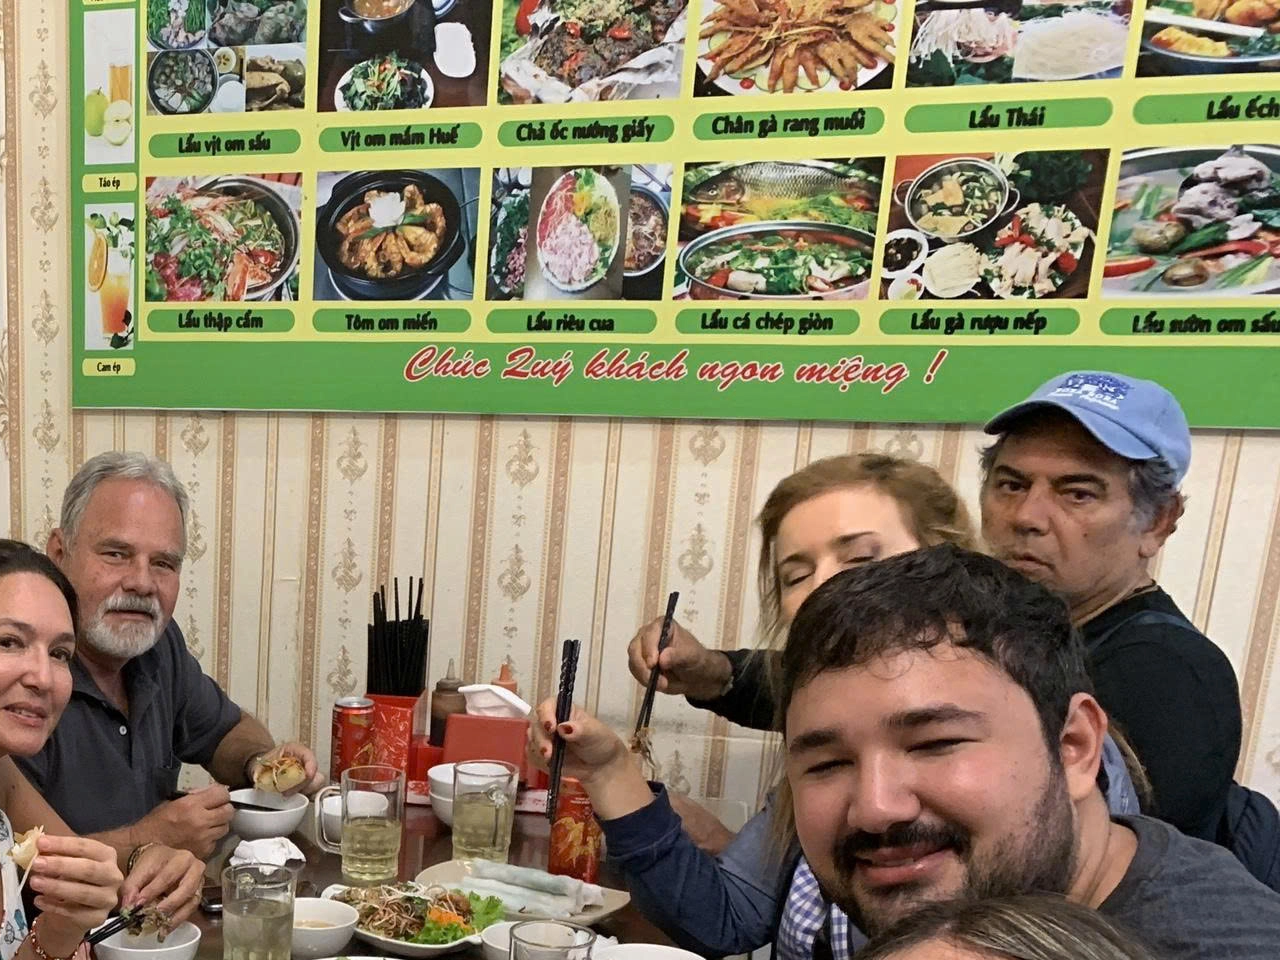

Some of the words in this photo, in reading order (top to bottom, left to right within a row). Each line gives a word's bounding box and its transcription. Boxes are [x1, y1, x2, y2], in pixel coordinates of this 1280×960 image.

[1006, 106, 1047, 127] Thái
[1245, 94, 1280, 119] ếch
[516, 121, 546, 142] Chả
[550, 119, 569, 140] ốc
[572, 120, 619, 144] nướng
[621, 116, 656, 143] giấy
[712, 114, 755, 135] Chân
[757, 114, 778, 138] gà
[782, 116, 821, 137] rang
[204, 135, 222, 156] vịt
[224, 138, 245, 151] om
[340, 130, 361, 151] Vịt
[364, 133, 386, 148] om
[428, 123, 461, 144] Huế
[98, 176, 111, 188] Táo
[112, 176, 121, 190] ép
[203, 311, 233, 332] thập
[344, 314, 375, 330] Tôm
[378, 318, 399, 330] om
[402, 310, 438, 330] miến
[556, 313, 586, 331] riêu
[588, 318, 615, 331] cua
[732, 311, 751, 330] cá
[755, 311, 795, 335] chép
[797, 312, 834, 335] giòn
[944, 311, 965, 335] gà
[969, 313, 1010, 335] rượu
[1012, 308, 1048, 335] nếp
[1216, 318, 1246, 333] om
[96, 361, 112, 372] Cam
[112, 361, 121, 375] ép
[404, 345, 492, 383] Chúc
[501, 345, 575, 387] Quý
[583, 348, 689, 382] khách
[696, 359, 785, 392] ngon
[794, 354, 910, 393] miệng
[923, 349, 949, 384] !
